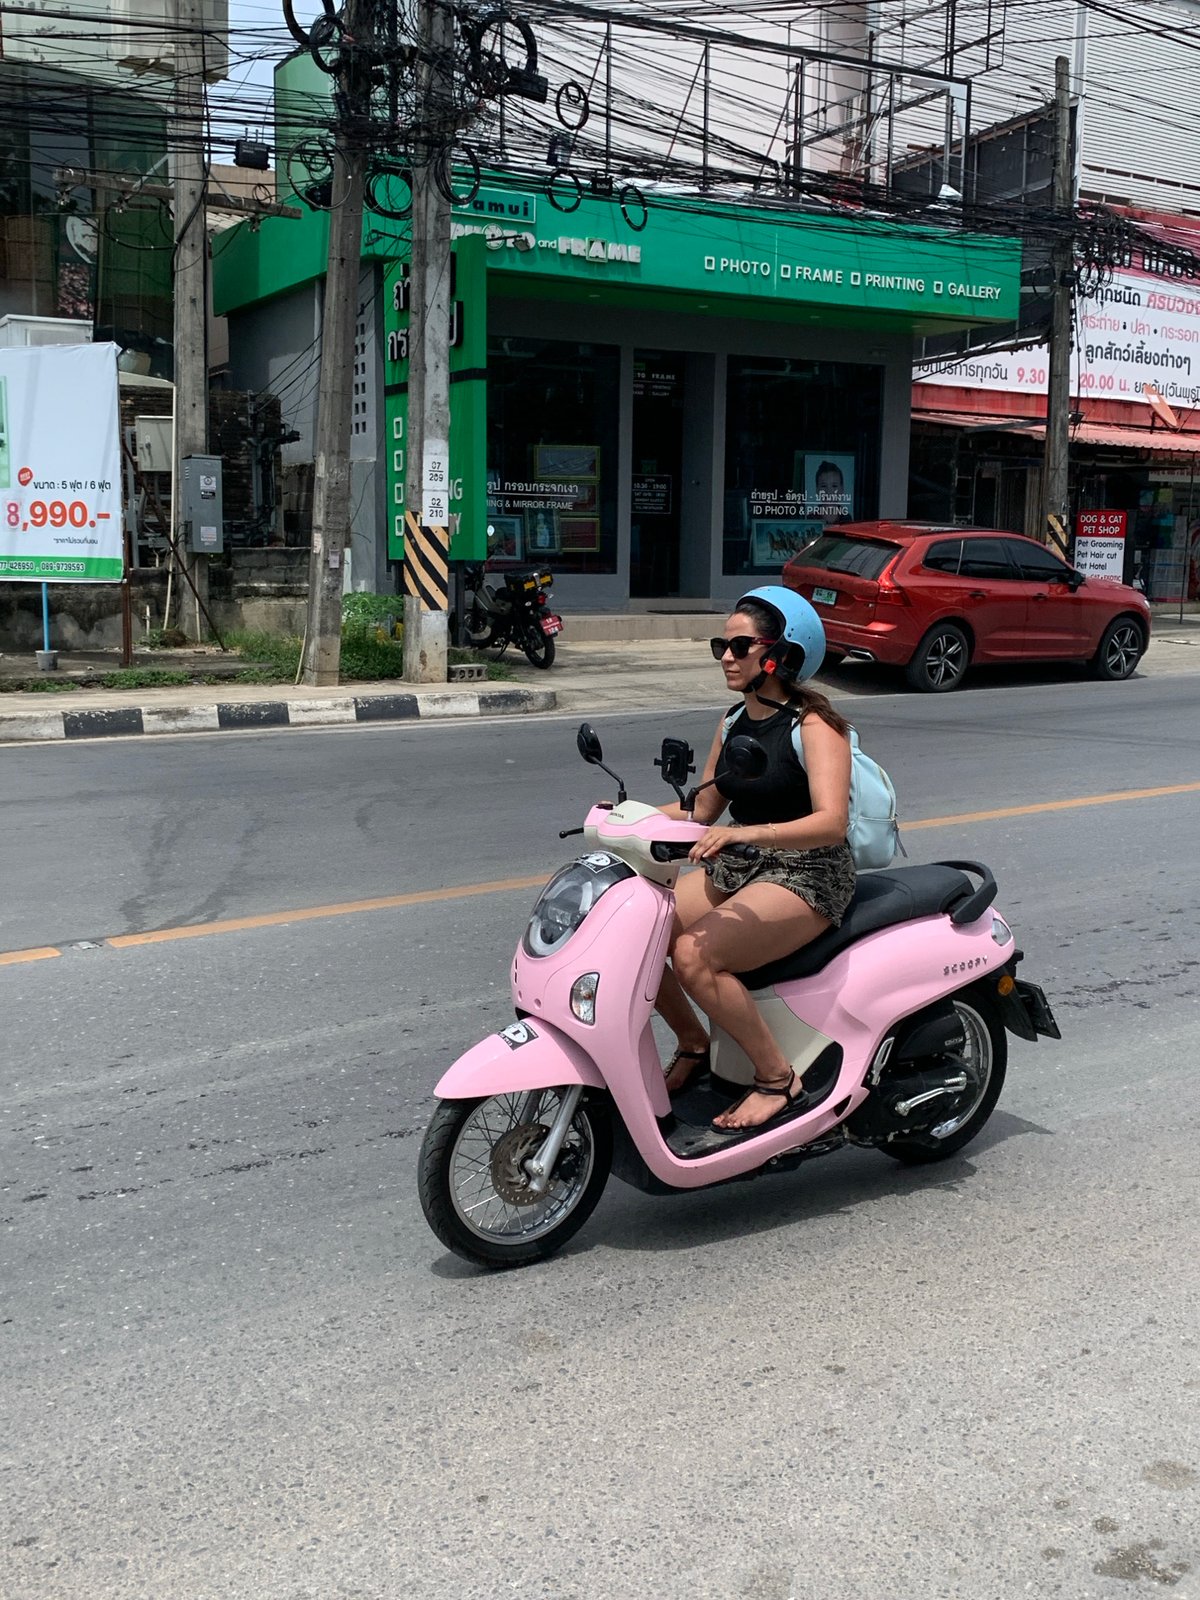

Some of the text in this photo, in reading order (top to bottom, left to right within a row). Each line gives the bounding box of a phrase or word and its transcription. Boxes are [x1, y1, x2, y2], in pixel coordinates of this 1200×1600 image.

[537, 239, 557, 249] and
[558, 236, 641, 263] FRAME
[719, 257, 1002, 300] PHOTO FRAME PRINTING GALLERY
[1130, 318, 1150, 335] ปลา
[1160, 326, 1199, 343] กระรอก
[1017, 367, 1046, 385] 9.30
[1079, 373, 1114, 390] 20.00
[33, 481, 56, 490] ขนาด
[61, 480, 68, 490] 5
[89, 480, 96, 490] 6
[751, 488, 778, 504] ถ่ายรูป
[431, 497, 442, 507] 02
[504, 499, 511, 508] &
[512, 500, 546, 509] MIRROR
[547, 501, 574, 510] FRAME
[429, 509, 443, 518] 210
[752, 505, 849, 516] ID PHOTO & PRINTING
[1080, 514, 1123, 523] DOG & CAT
[1082, 526, 1120, 535] PET SHOP
[1077, 539, 1123, 551] Pet Grooming
[1077, 550, 1117, 560] Pet Hair cut
[1076, 561, 1107, 570] Pet Hotel
